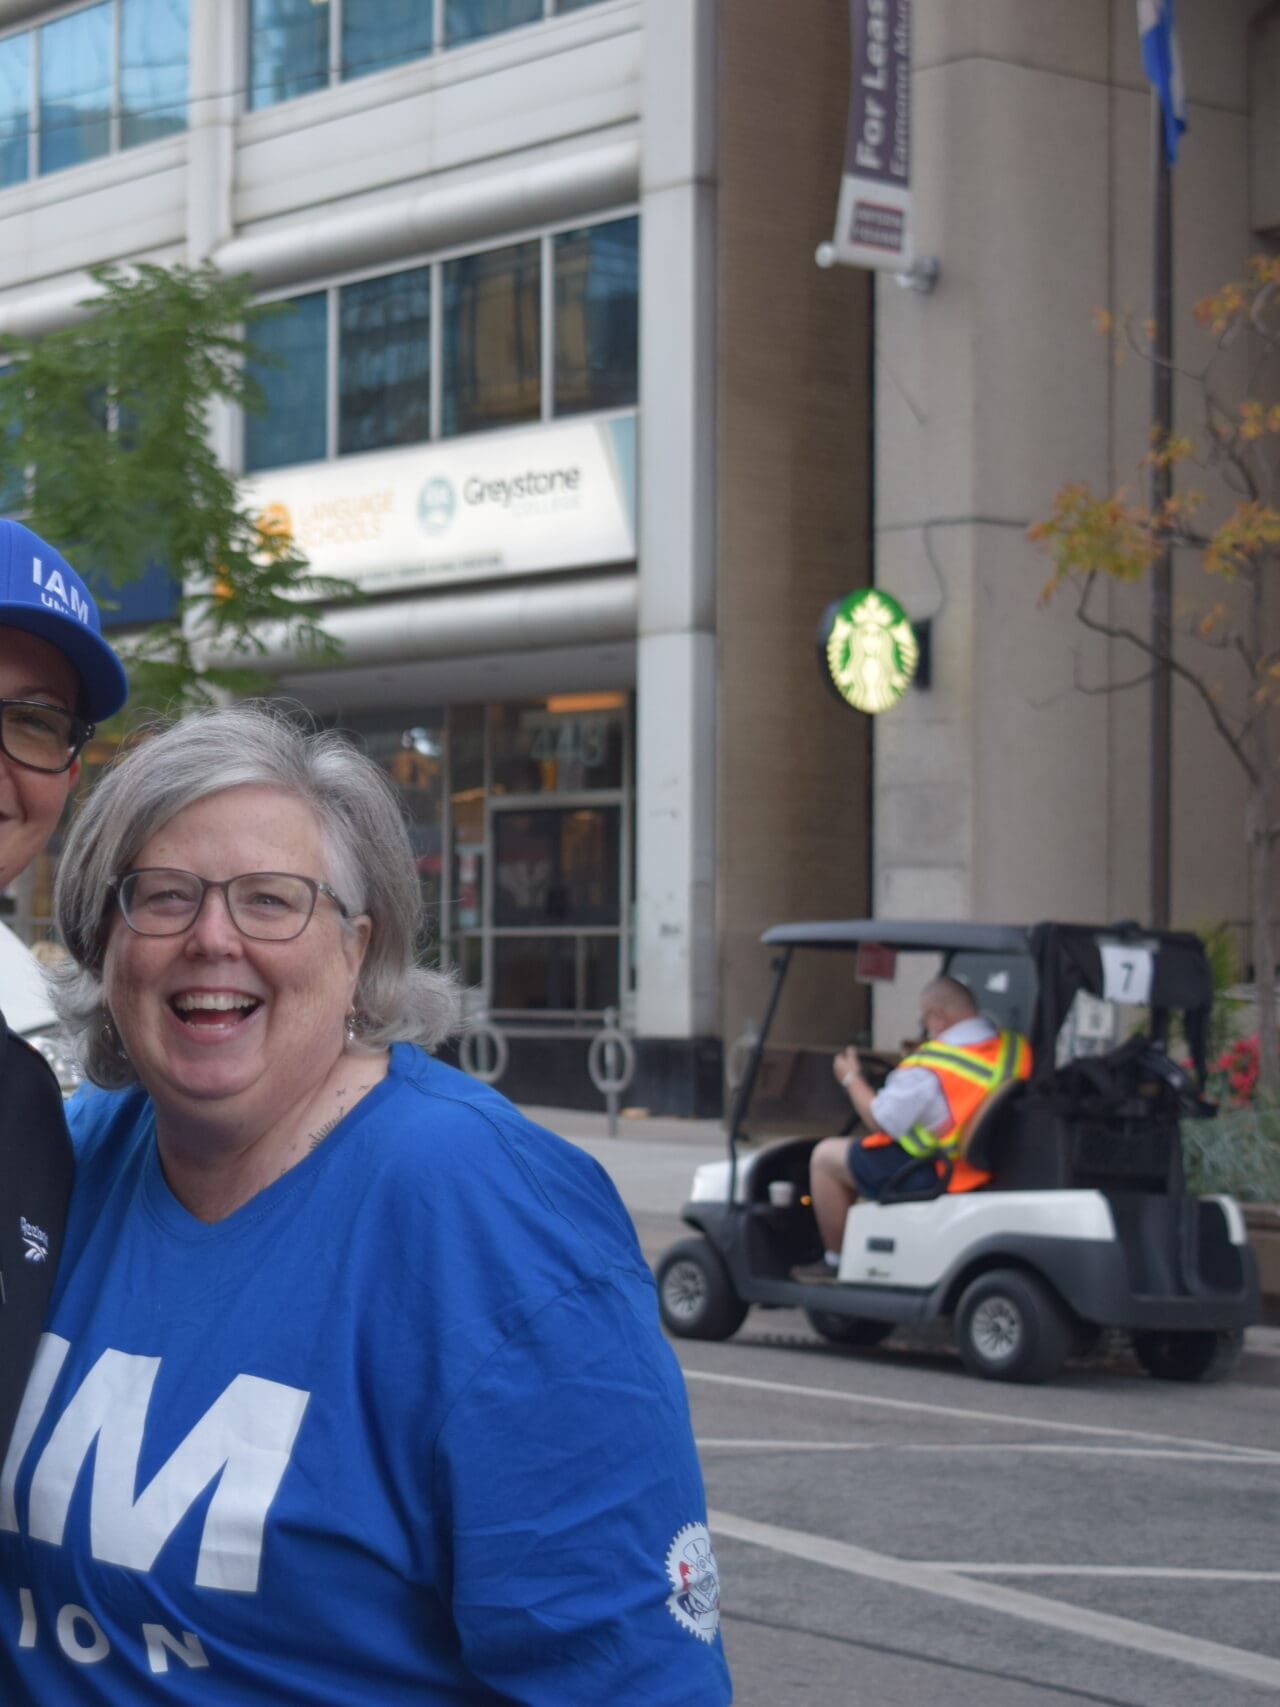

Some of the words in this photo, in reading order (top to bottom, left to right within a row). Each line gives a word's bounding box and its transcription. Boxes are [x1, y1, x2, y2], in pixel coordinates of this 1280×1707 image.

[855, 96, 888, 169] For
[464, 466, 581, 509] Greystone
[33, 557, 89, 624] IAM
[1121, 961, 1135, 993] 7
